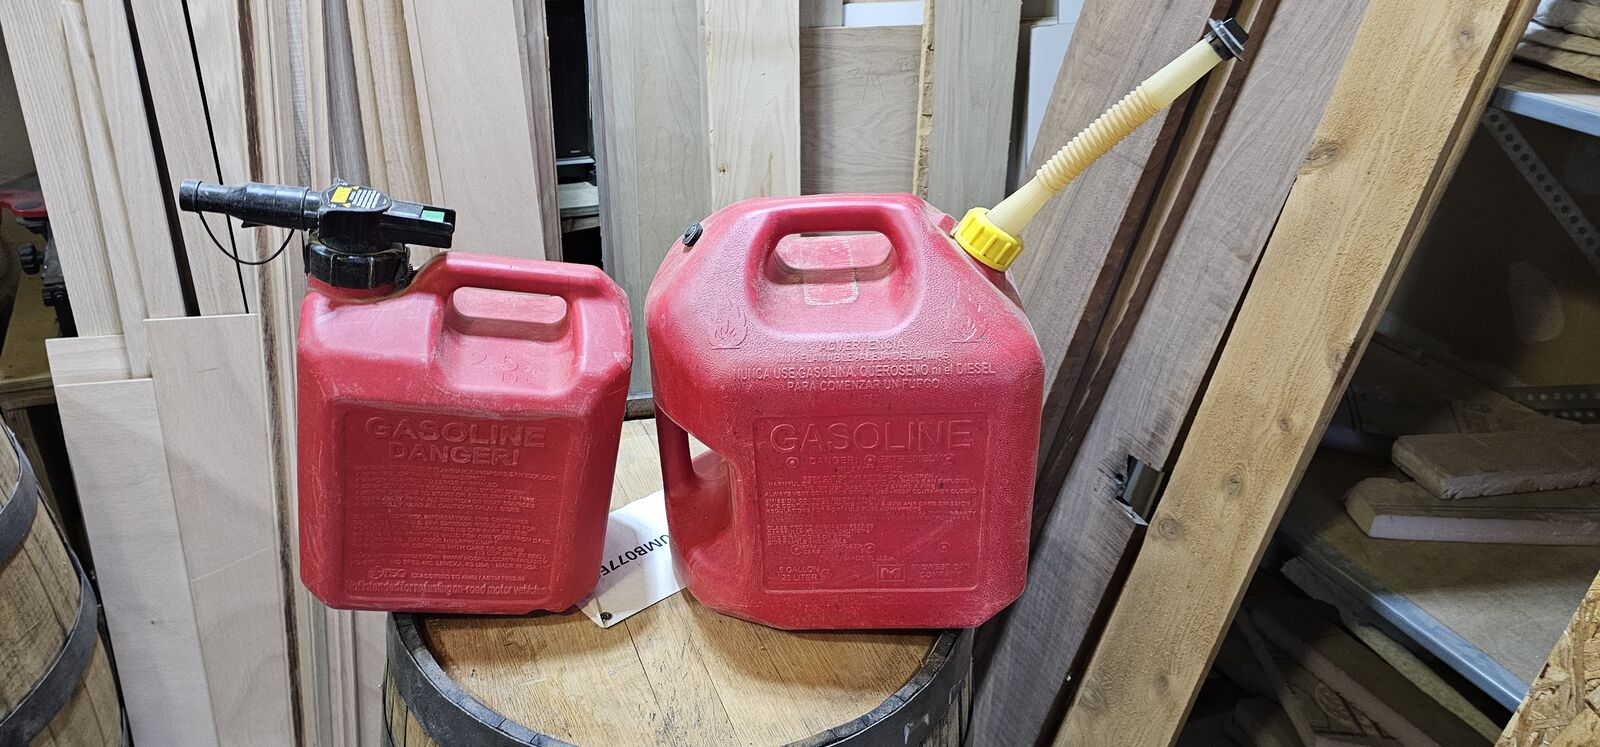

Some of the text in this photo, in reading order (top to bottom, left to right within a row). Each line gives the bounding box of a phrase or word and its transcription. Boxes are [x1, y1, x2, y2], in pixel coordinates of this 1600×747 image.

[773, 366, 797, 379] USE
[860, 363, 929, 377] QUEROSENO
[956, 361, 997, 375] DIESEL
[787, 377, 941, 391] PARA COMENZAR UN FUEGO
[365, 416, 547, 448] GASOLINE
[769, 419, 973, 451] GASOLINE
[388, 441, 520, 466] DANGER!
[599, 534, 670, 578] UMB077E
[786, 565, 820, 573] GALLON
[792, 573, 818, 581] LITER
